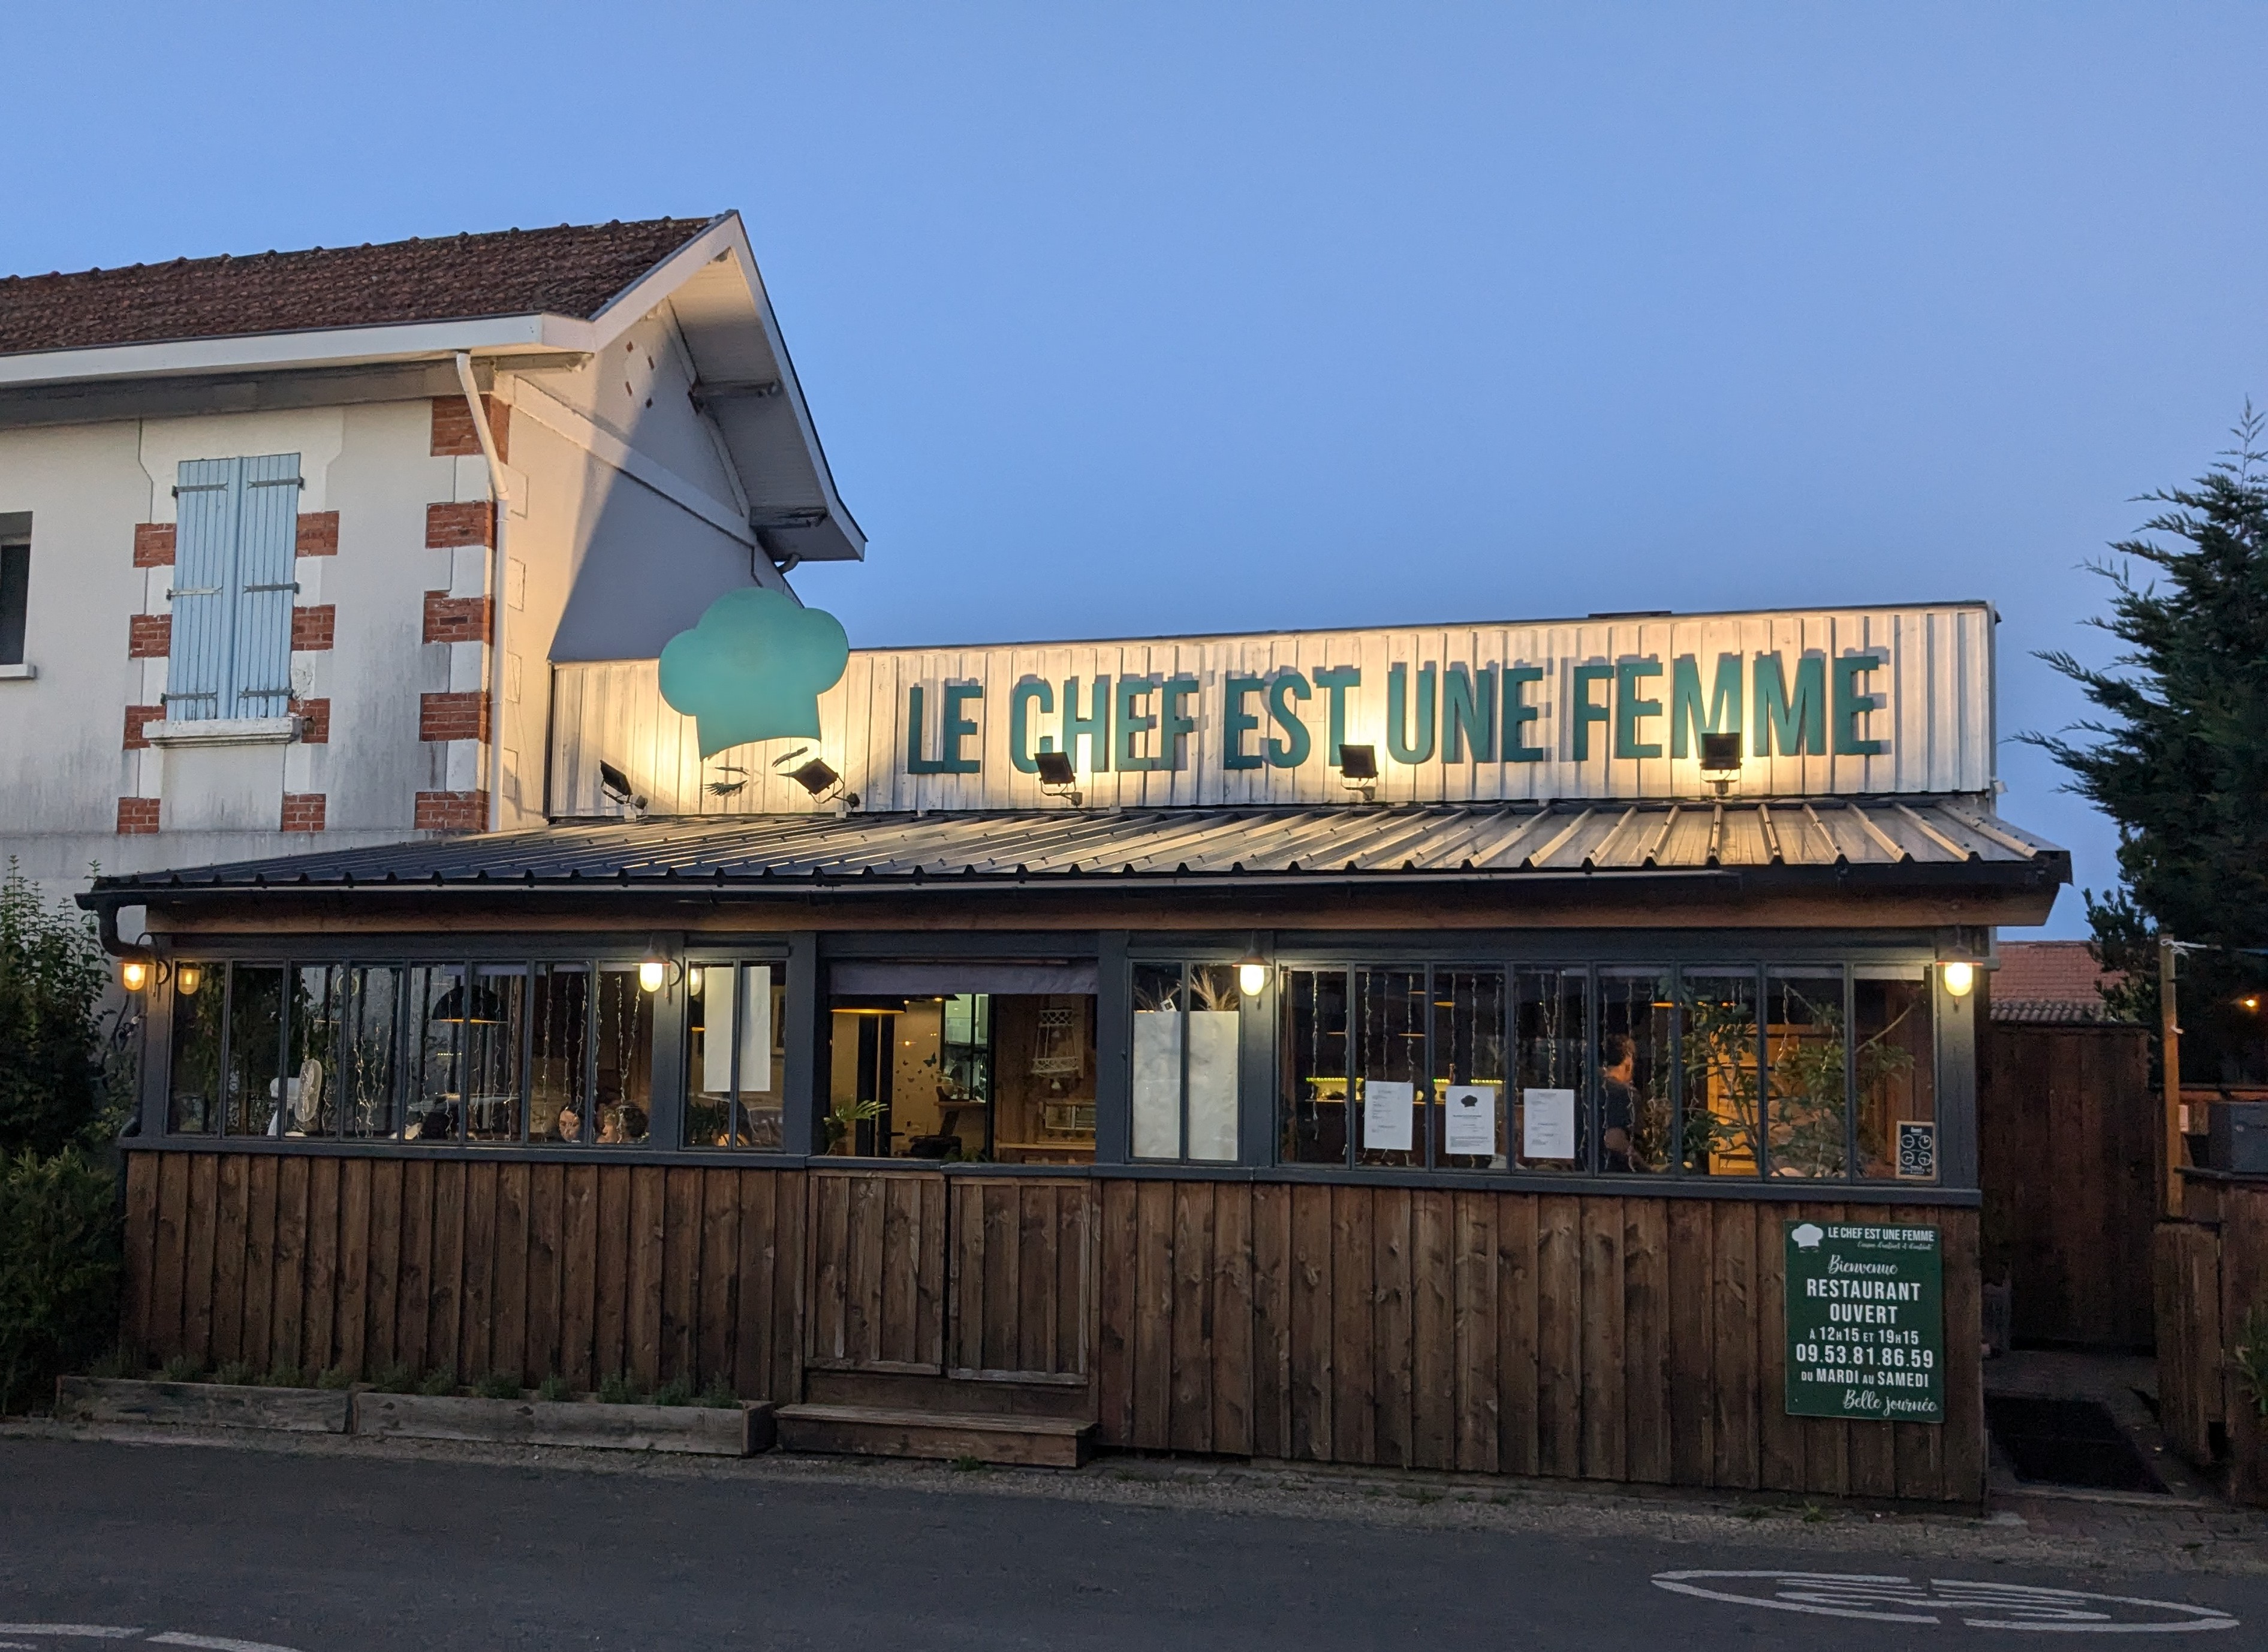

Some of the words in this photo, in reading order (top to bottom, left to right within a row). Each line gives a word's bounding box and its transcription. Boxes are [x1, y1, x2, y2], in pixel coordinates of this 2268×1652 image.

[908, 685, 984, 774] LE
[1011, 680, 1199, 774] CHEF
[1223, 669, 1361, 770] EST
[1387, 666, 1544, 765] UNE
[1573, 655, 1881, 762] FEMME
[1828, 1227, 1839, 1238] LE
[1840, 1228, 1862, 1239] CHEF
[1864, 1228, 1881, 1240] EST
[1883, 1229, 1900, 1240] UNE
[1902, 1230, 1935, 1241] FEMME
[1828, 1254, 1898, 1275] Bienvenue
[1806, 1278, 1921, 1301] RESTAURANT
[1830, 1303, 1898, 1324] OUVERT
[1820, 1327, 1859, 1342] 12H15
[1863, 1332, 1874, 1343] ET
[1878, 1330, 1919, 1344] 19H15
[1796, 1343, 1933, 1368] 09.53.81.86.59
[1801, 1371, 1813, 1381] DU
[1816, 1368, 1859, 1384] MARDI
[1862, 1374, 1874, 1385] AU
[1877, 1371, 1929, 1388] SAMEDI
[1844, 1389, 1881, 1409] Belle
[1883, 1396, 1939, 1416] journée
